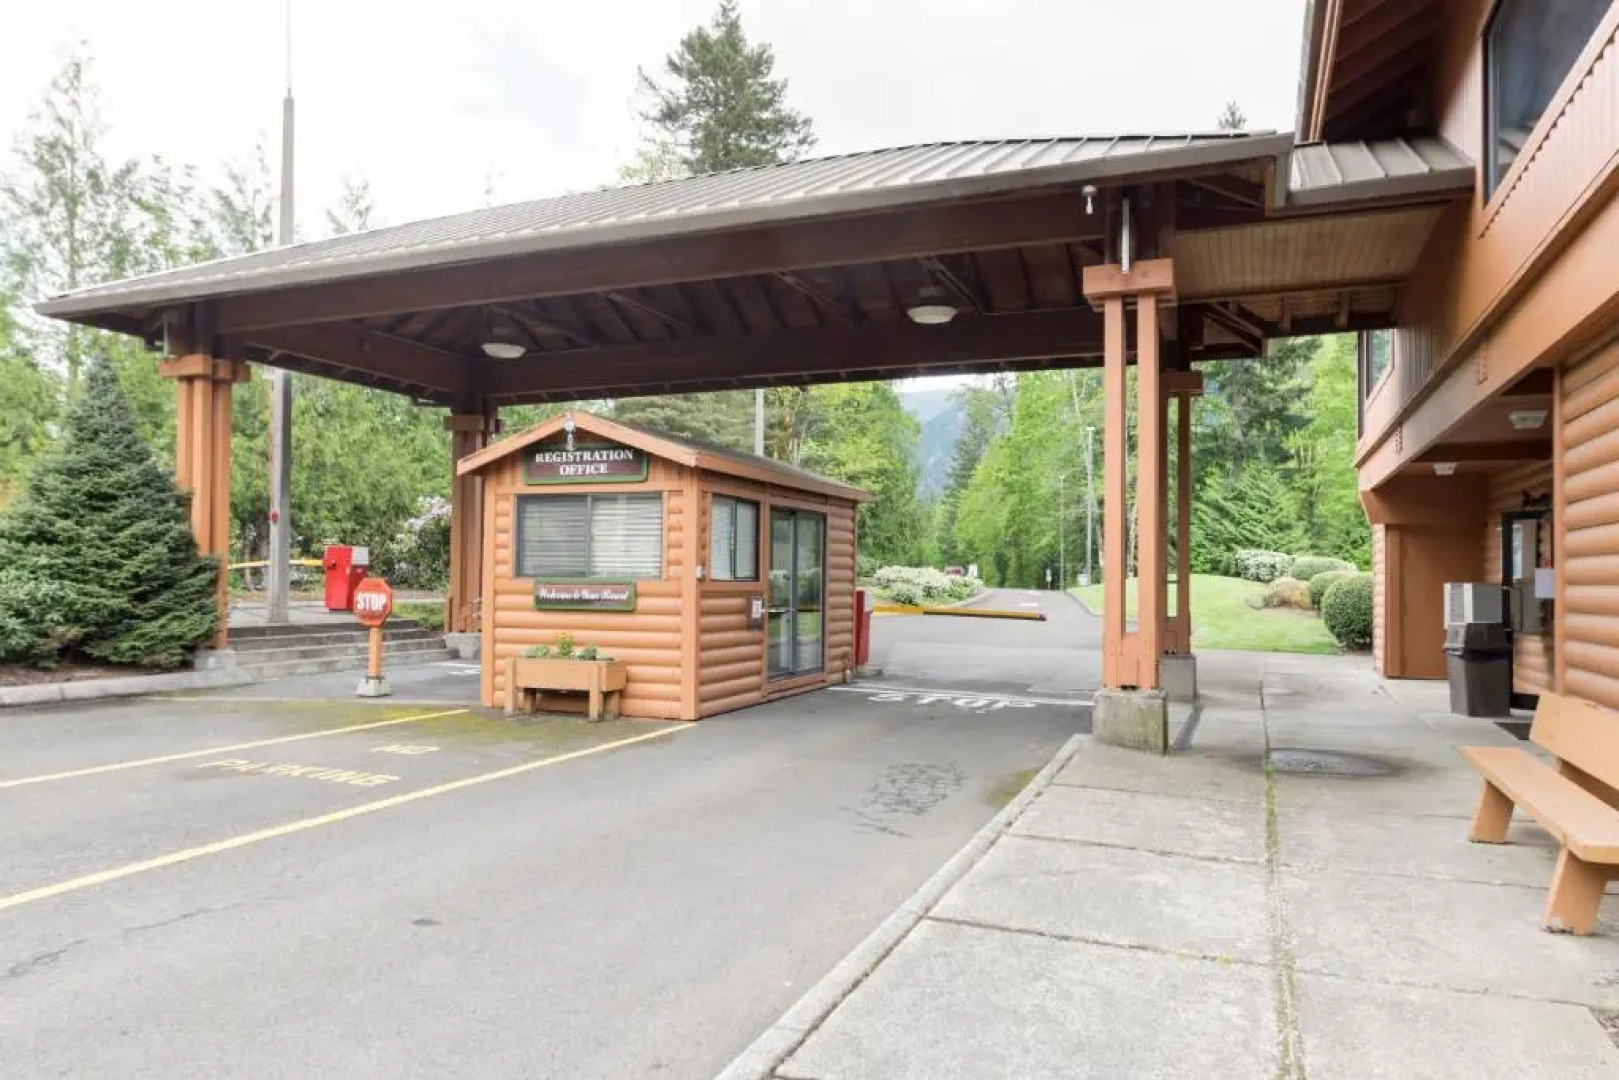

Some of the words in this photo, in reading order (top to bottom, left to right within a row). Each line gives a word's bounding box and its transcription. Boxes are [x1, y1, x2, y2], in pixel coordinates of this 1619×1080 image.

[535, 448, 634, 463] REGISTRATION
[559, 462, 608, 476] OFFICE
[356, 592, 387, 611] STOP
[867, 693, 1037, 711] STOP
[195, 758, 401, 787] PARKING
